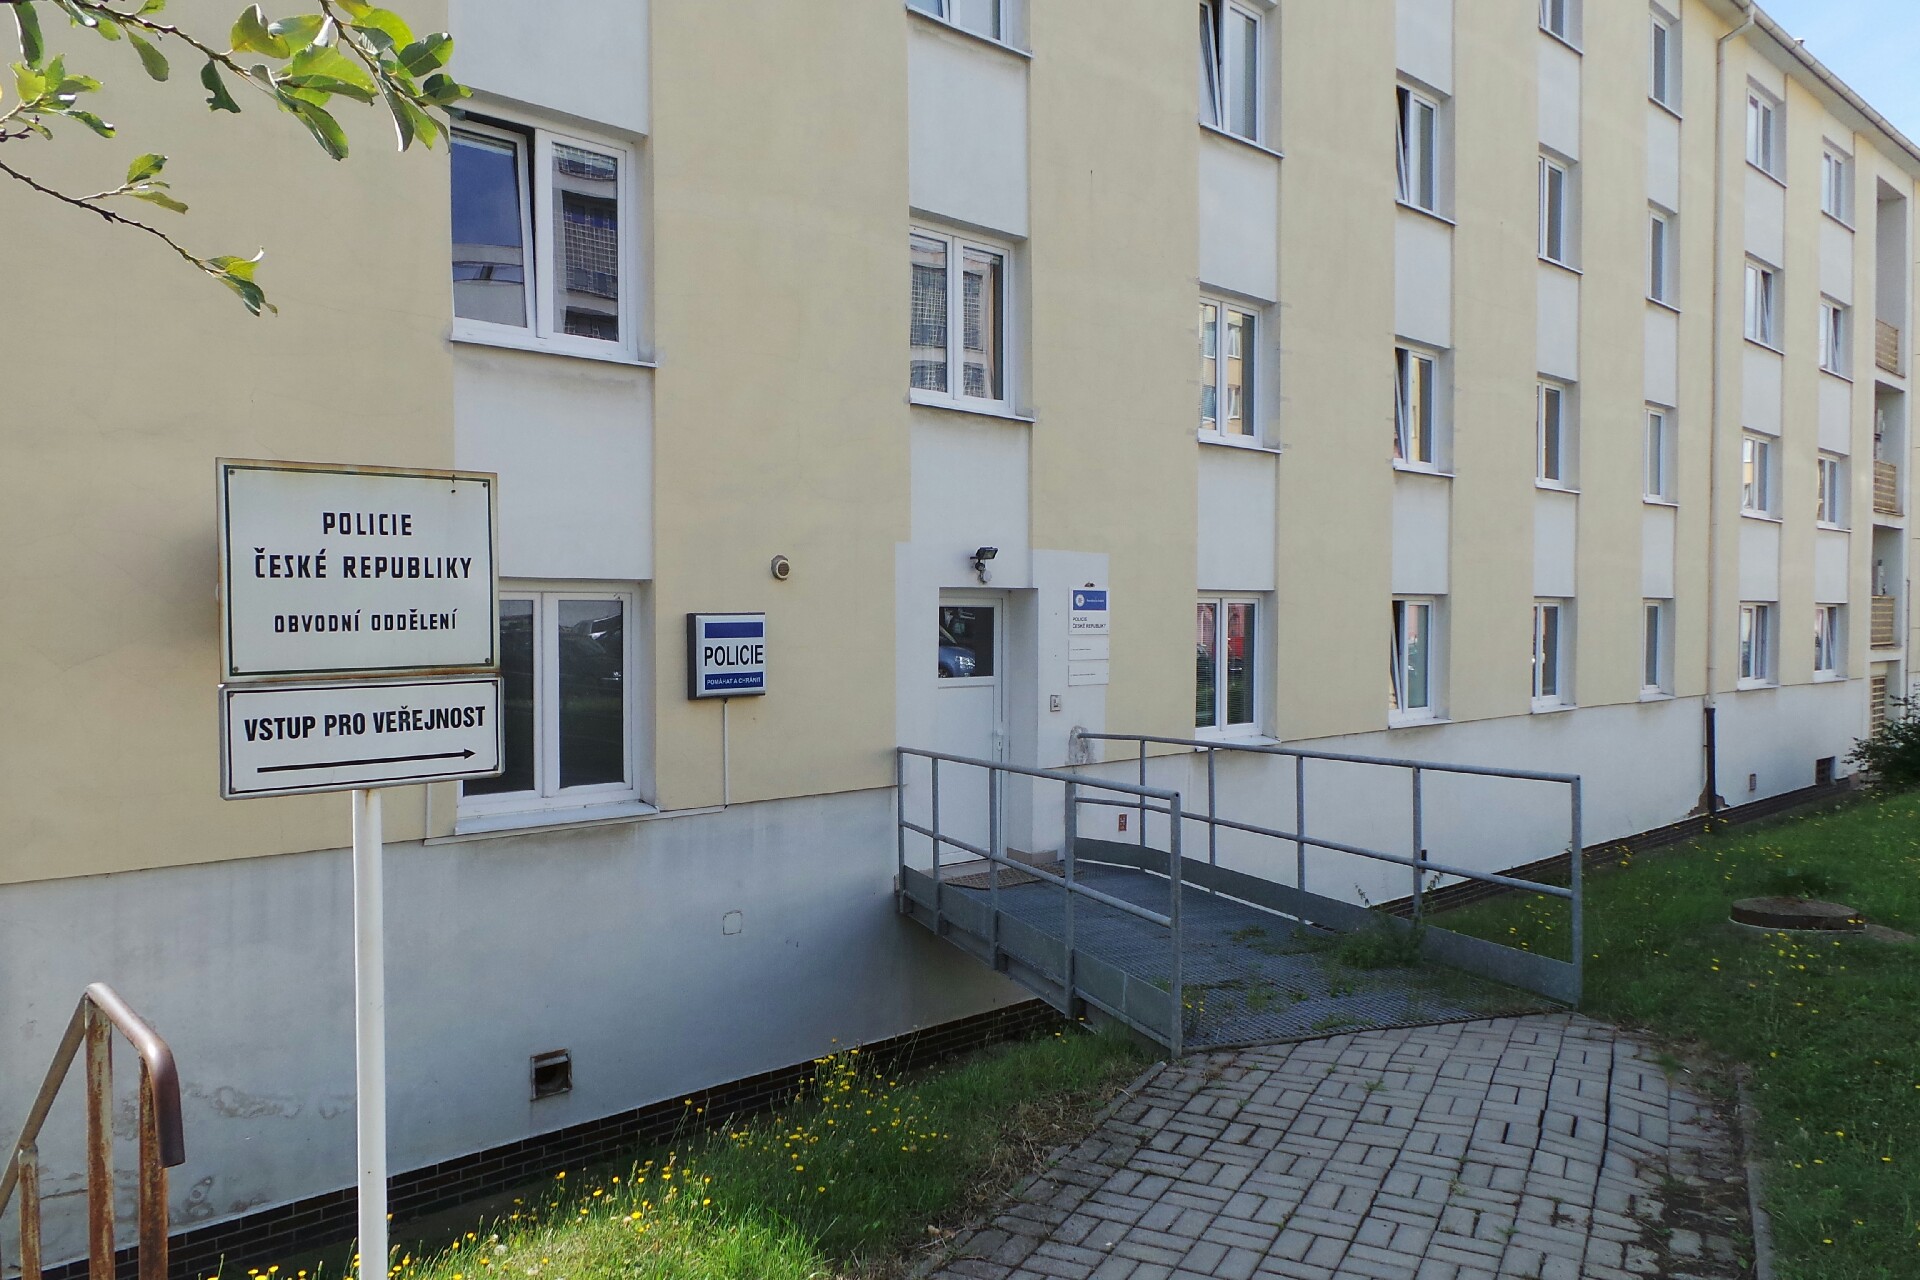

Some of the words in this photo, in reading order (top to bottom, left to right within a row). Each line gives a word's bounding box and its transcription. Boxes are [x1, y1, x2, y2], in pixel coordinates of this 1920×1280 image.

[322, 512, 412, 536] POLICIE
[254, 547, 327, 579] ČESKÉ
[343, 556, 472, 579] REPUBLIKY
[274, 608, 361, 633] OBVODNÍ
[371, 608, 458, 631] ODDĚLENÍ
[704, 644, 764, 667] POLICIE
[244, 716, 316, 742] VSTUP
[324, 712, 366, 737] PRO
[373, 705, 486, 734] VEŘEJNOST
